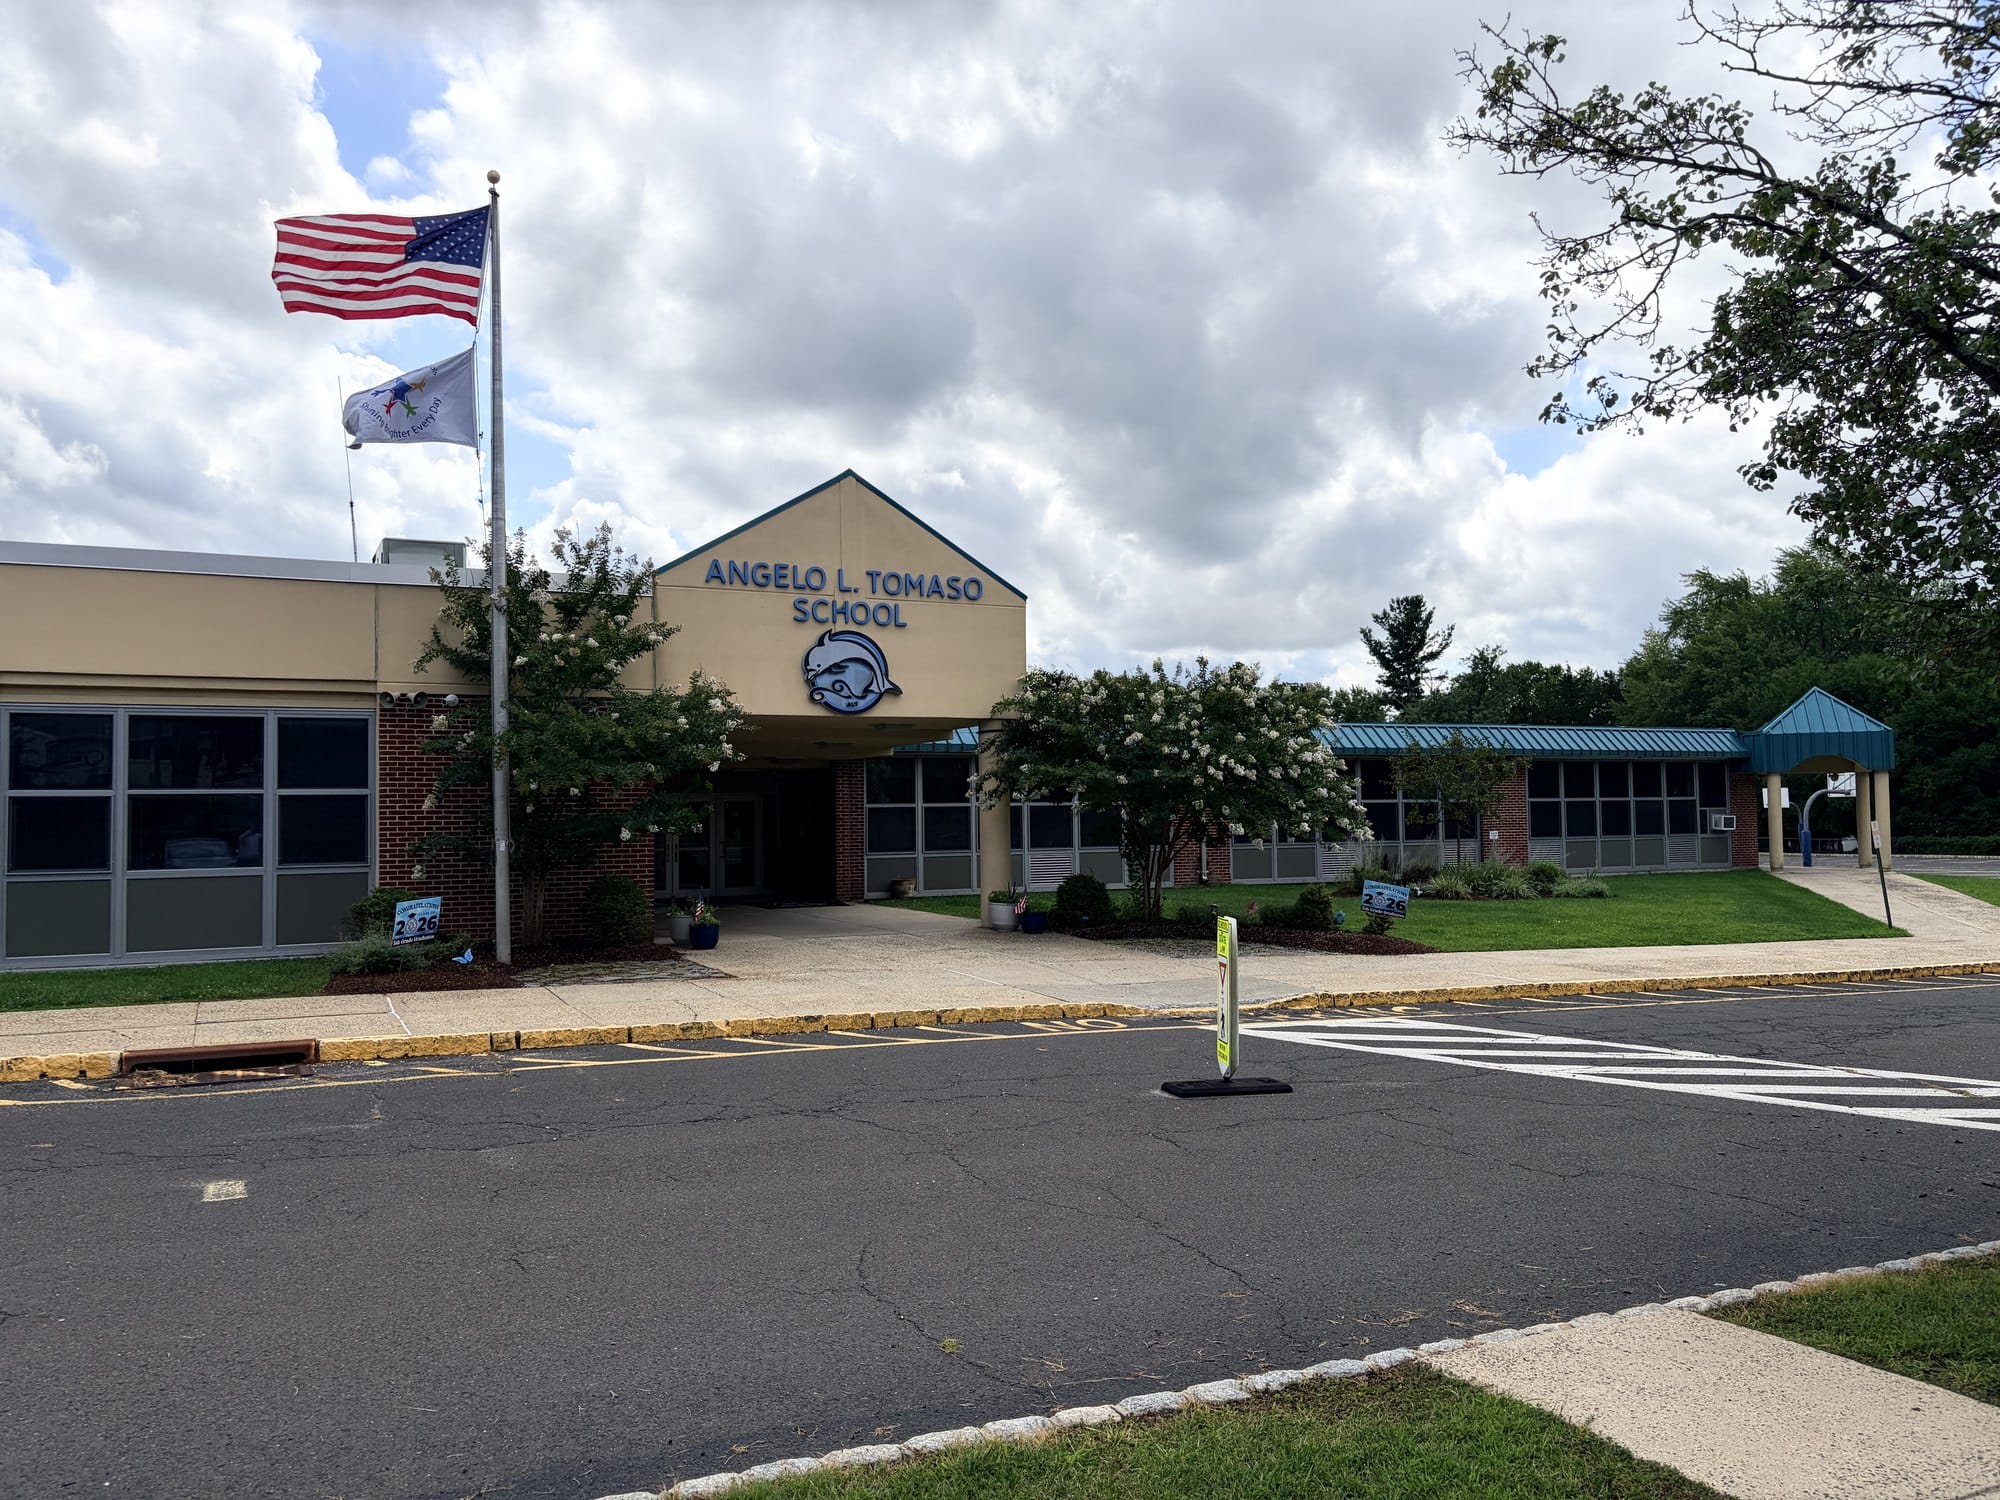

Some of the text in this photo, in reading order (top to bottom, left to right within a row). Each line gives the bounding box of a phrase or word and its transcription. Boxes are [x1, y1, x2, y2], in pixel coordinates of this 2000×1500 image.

[411, 413, 436, 434] Every
[429, 397, 442, 416] Day
[705, 559, 984, 600] ANGELO L. TOMASO
[793, 597, 908, 627] SCHOOL
[1019, 1018, 1128, 1032] NO
